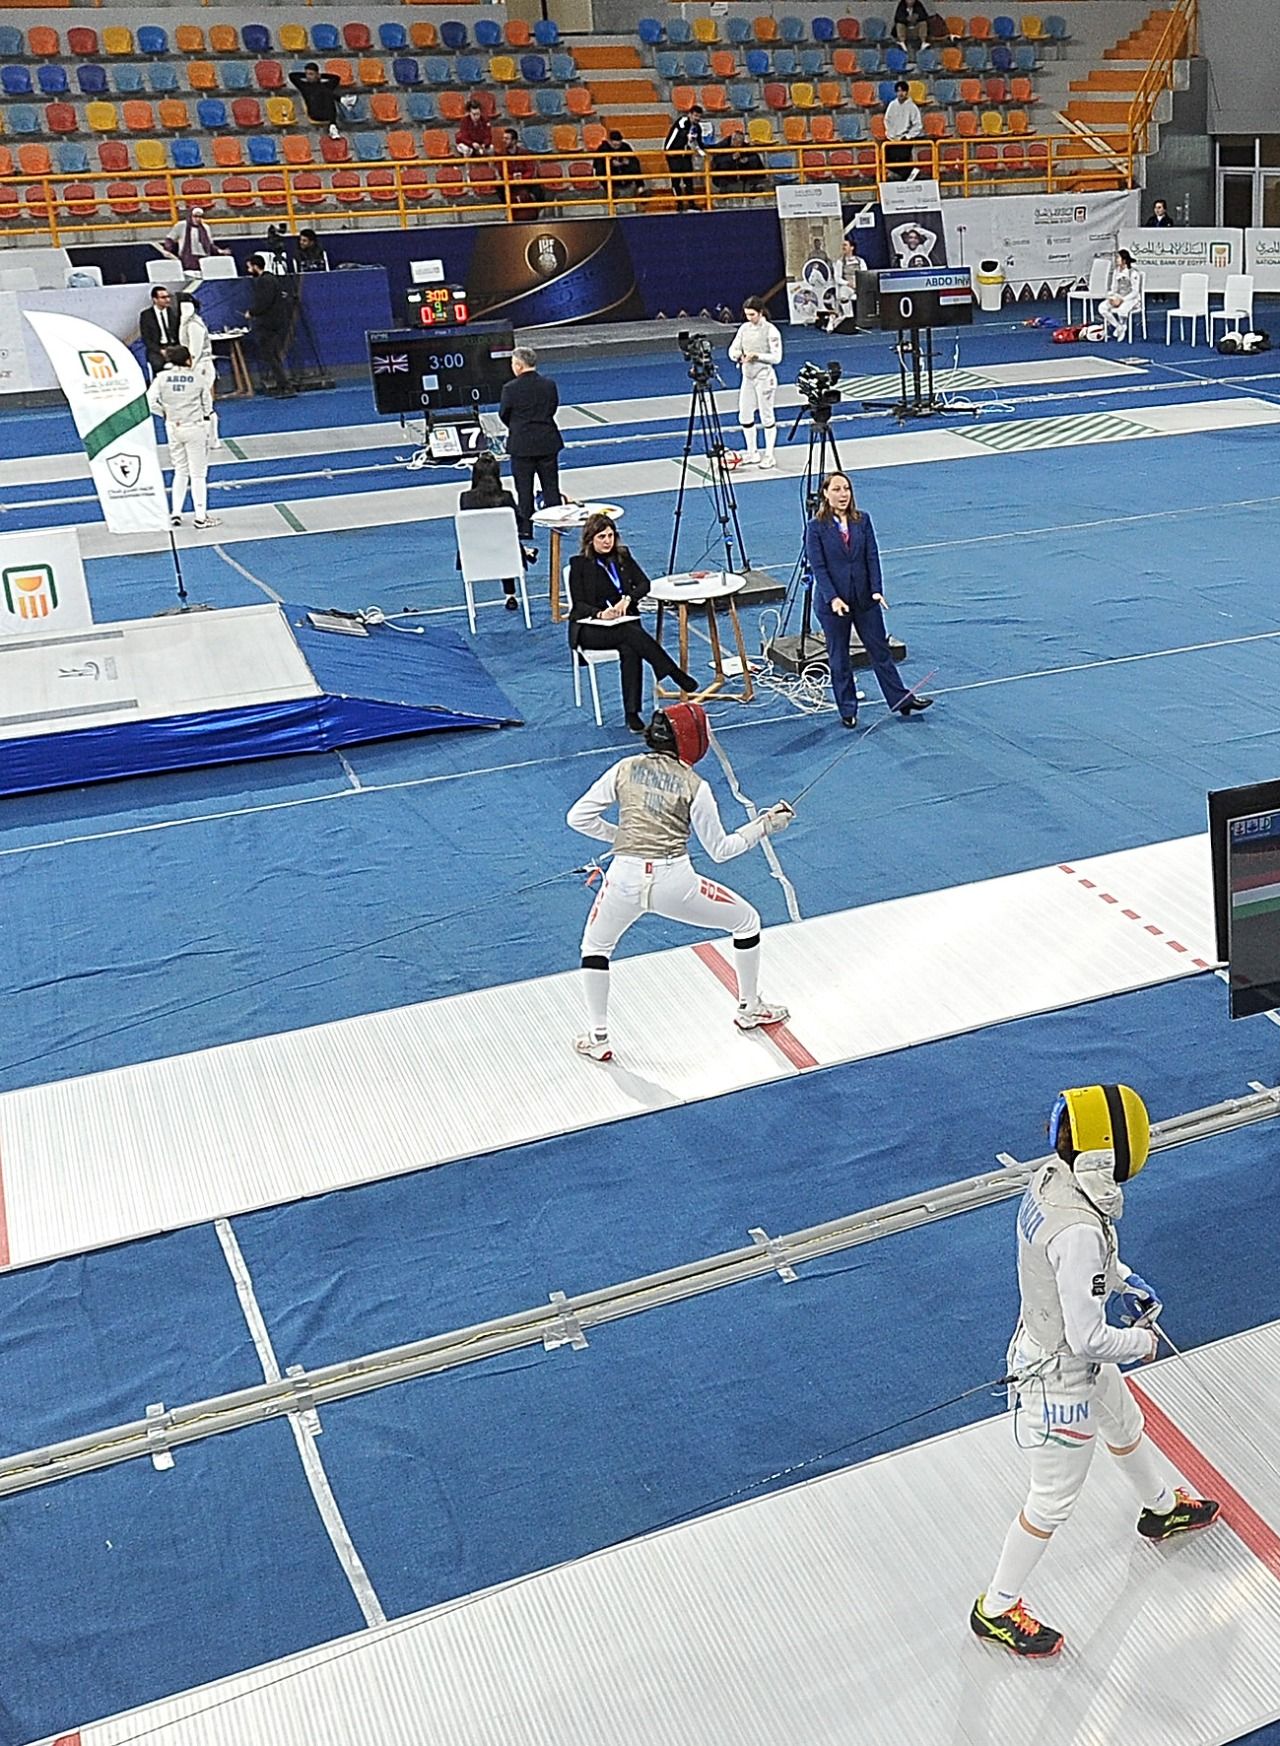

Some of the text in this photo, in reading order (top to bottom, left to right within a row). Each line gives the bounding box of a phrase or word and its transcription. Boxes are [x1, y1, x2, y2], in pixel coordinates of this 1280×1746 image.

[926, 276, 952, 287] ABDO
[425, 289, 449, 303] 3:00
[421, 304, 467, 324] 0 0
[434, 301, 442, 313] 9
[900, 296, 913, 318] 0
[429, 353, 465, 370] 3:00
[421, 389, 480, 405] 0 0
[460, 427, 481, 449] 7
[1043, 1400, 1088, 1424] HUN
